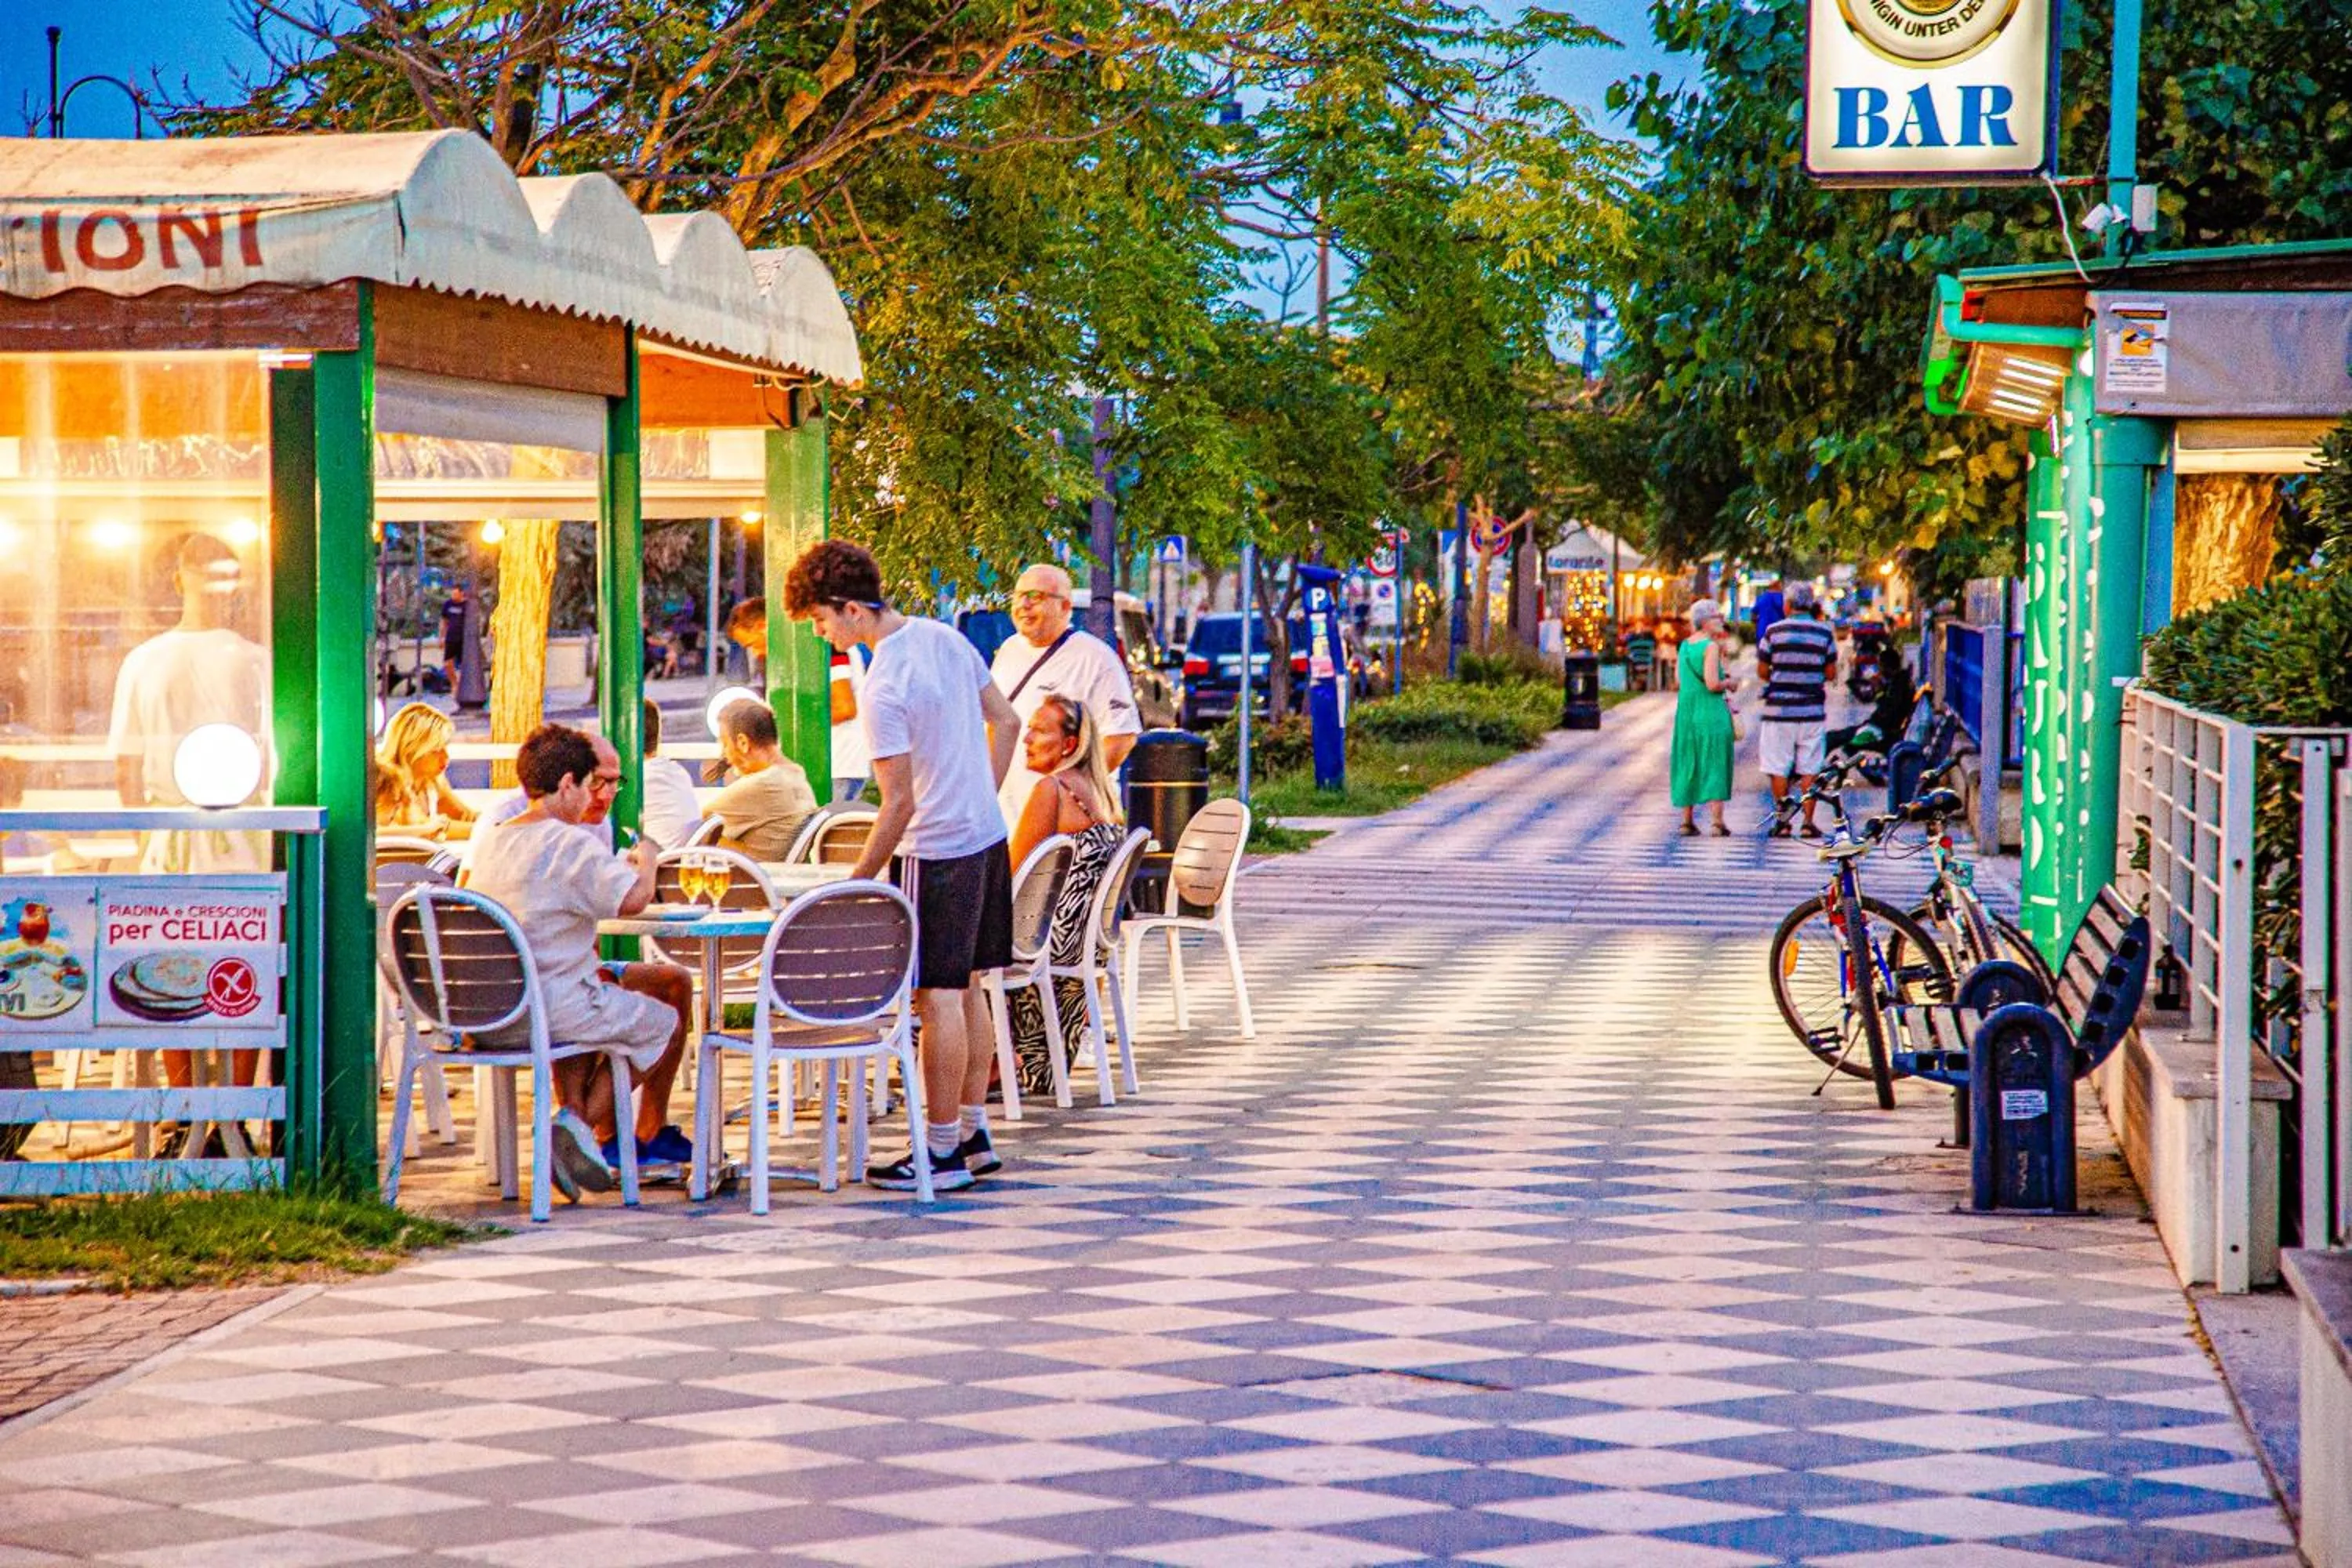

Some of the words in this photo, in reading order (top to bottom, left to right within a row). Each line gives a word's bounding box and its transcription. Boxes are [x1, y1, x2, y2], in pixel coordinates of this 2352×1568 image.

[1904, 16, 1962, 37] UNTER
[1958, 0, 1985, 22] DE
[1831, 82, 2018, 149] BAR
[11, 208, 263, 273] IONI
[1311, 586, 1327, 610] P
[108, 904, 169, 916] PIADINA
[174, 908, 183, 917] e
[188, 905, 267, 918] CRESCIONI
[109, 923, 153, 945] per
[162, 919, 267, 942] CELIACI
